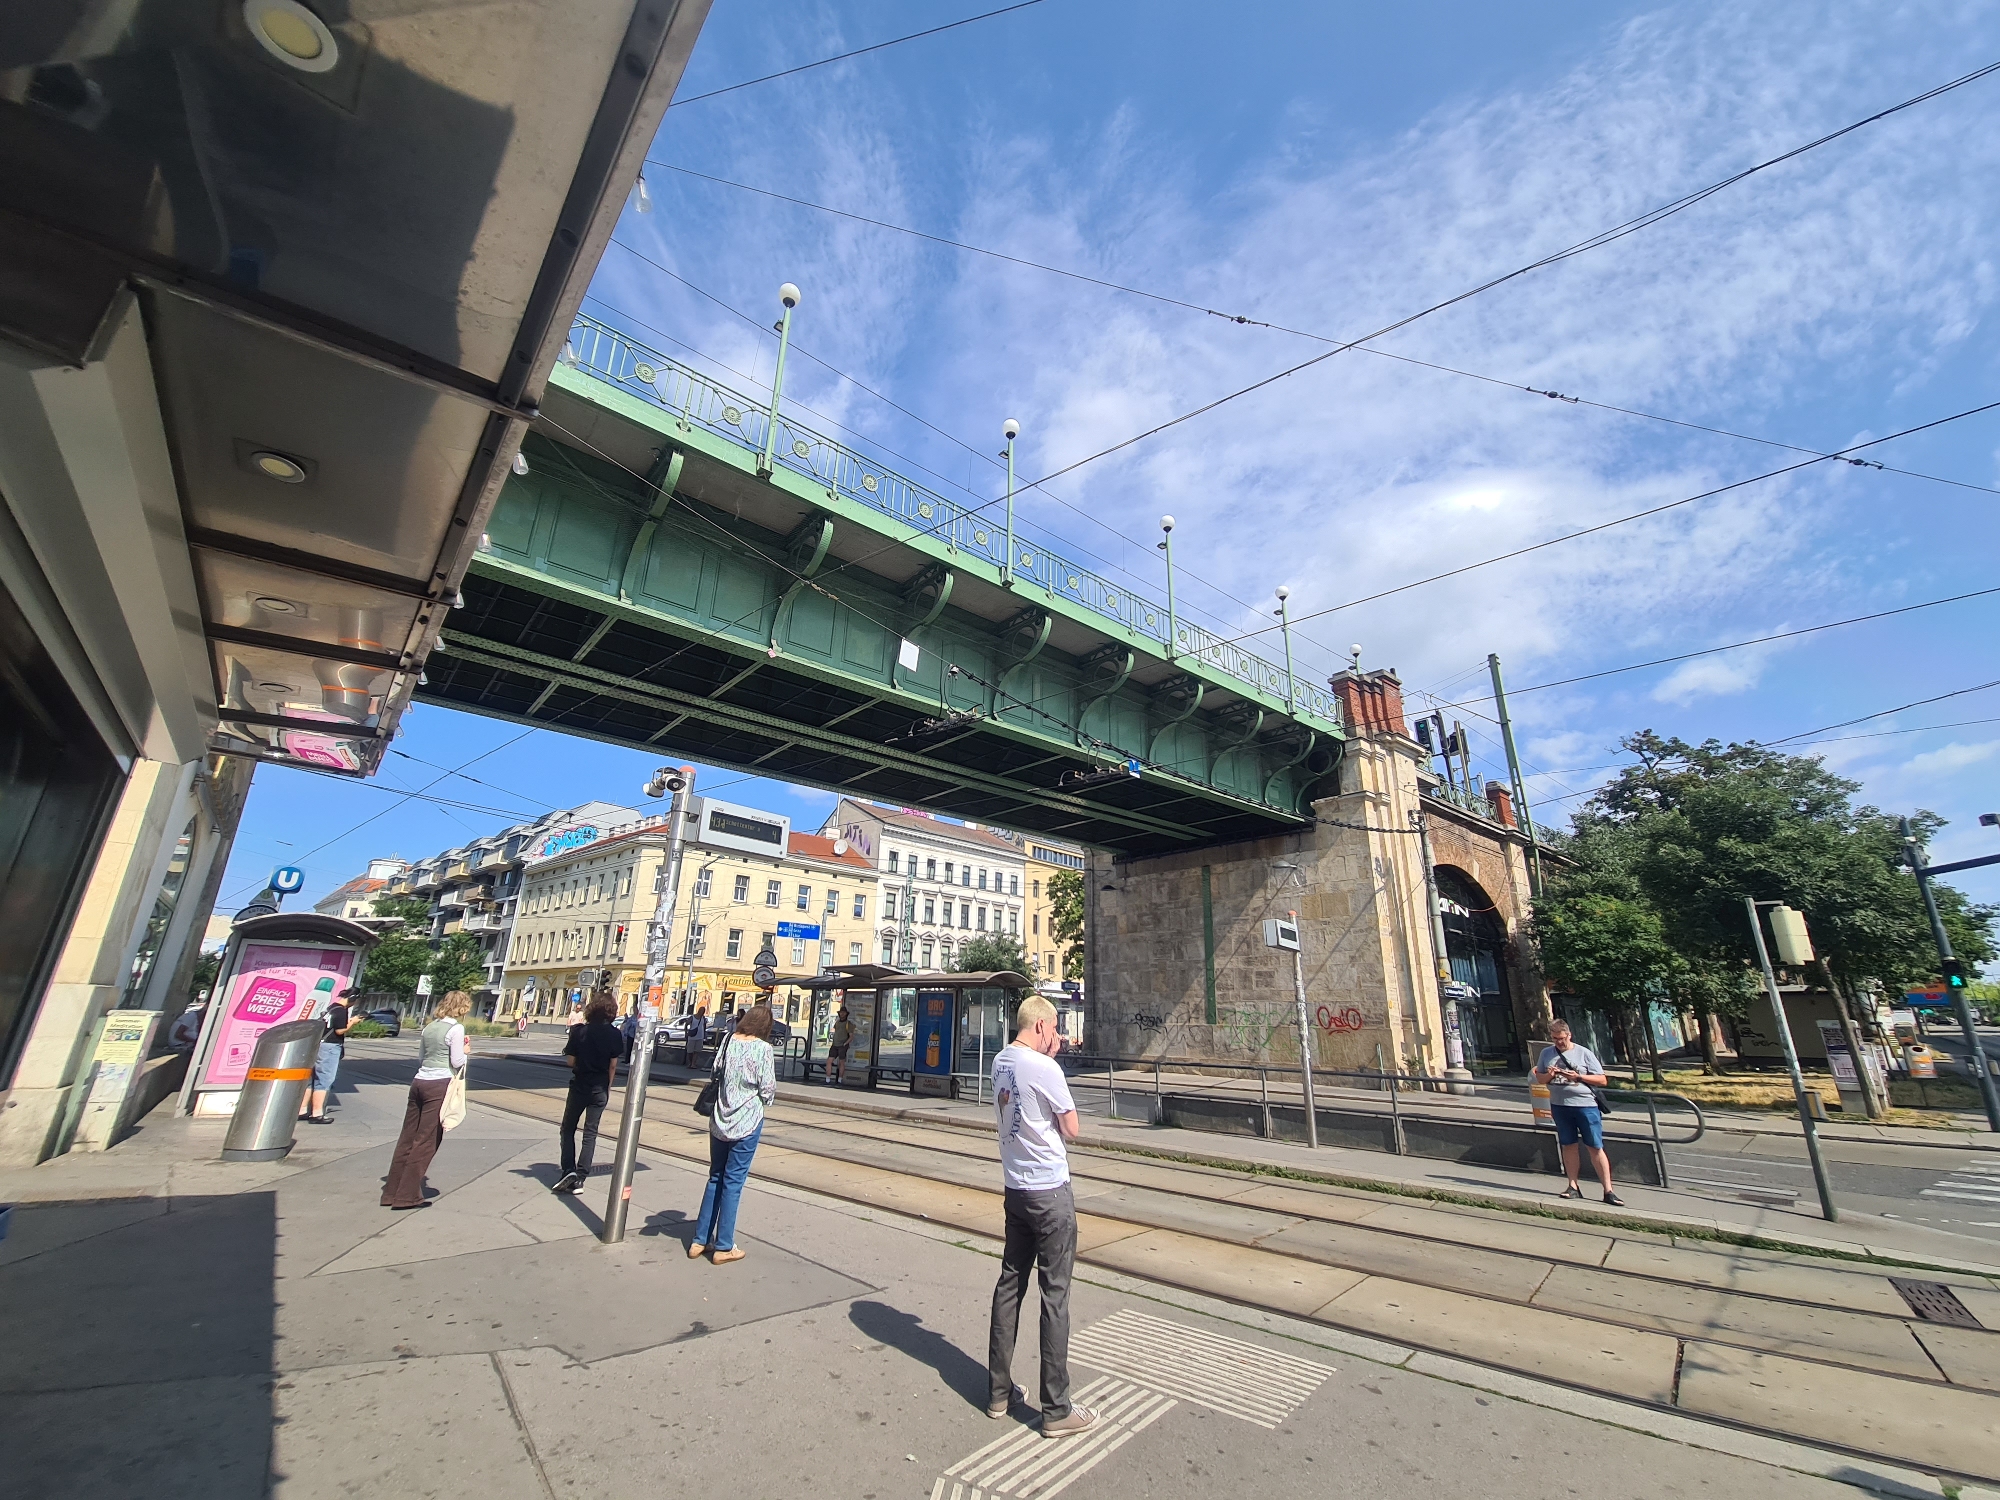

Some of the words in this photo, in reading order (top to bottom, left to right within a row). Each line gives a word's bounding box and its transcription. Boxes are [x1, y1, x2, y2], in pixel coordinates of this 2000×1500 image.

[277, 870, 300, 889] U
[255, 986, 291, 998] EINFACH
[250, 994, 287, 1007] PREIS
[246, 1003, 282, 1016] WERT
